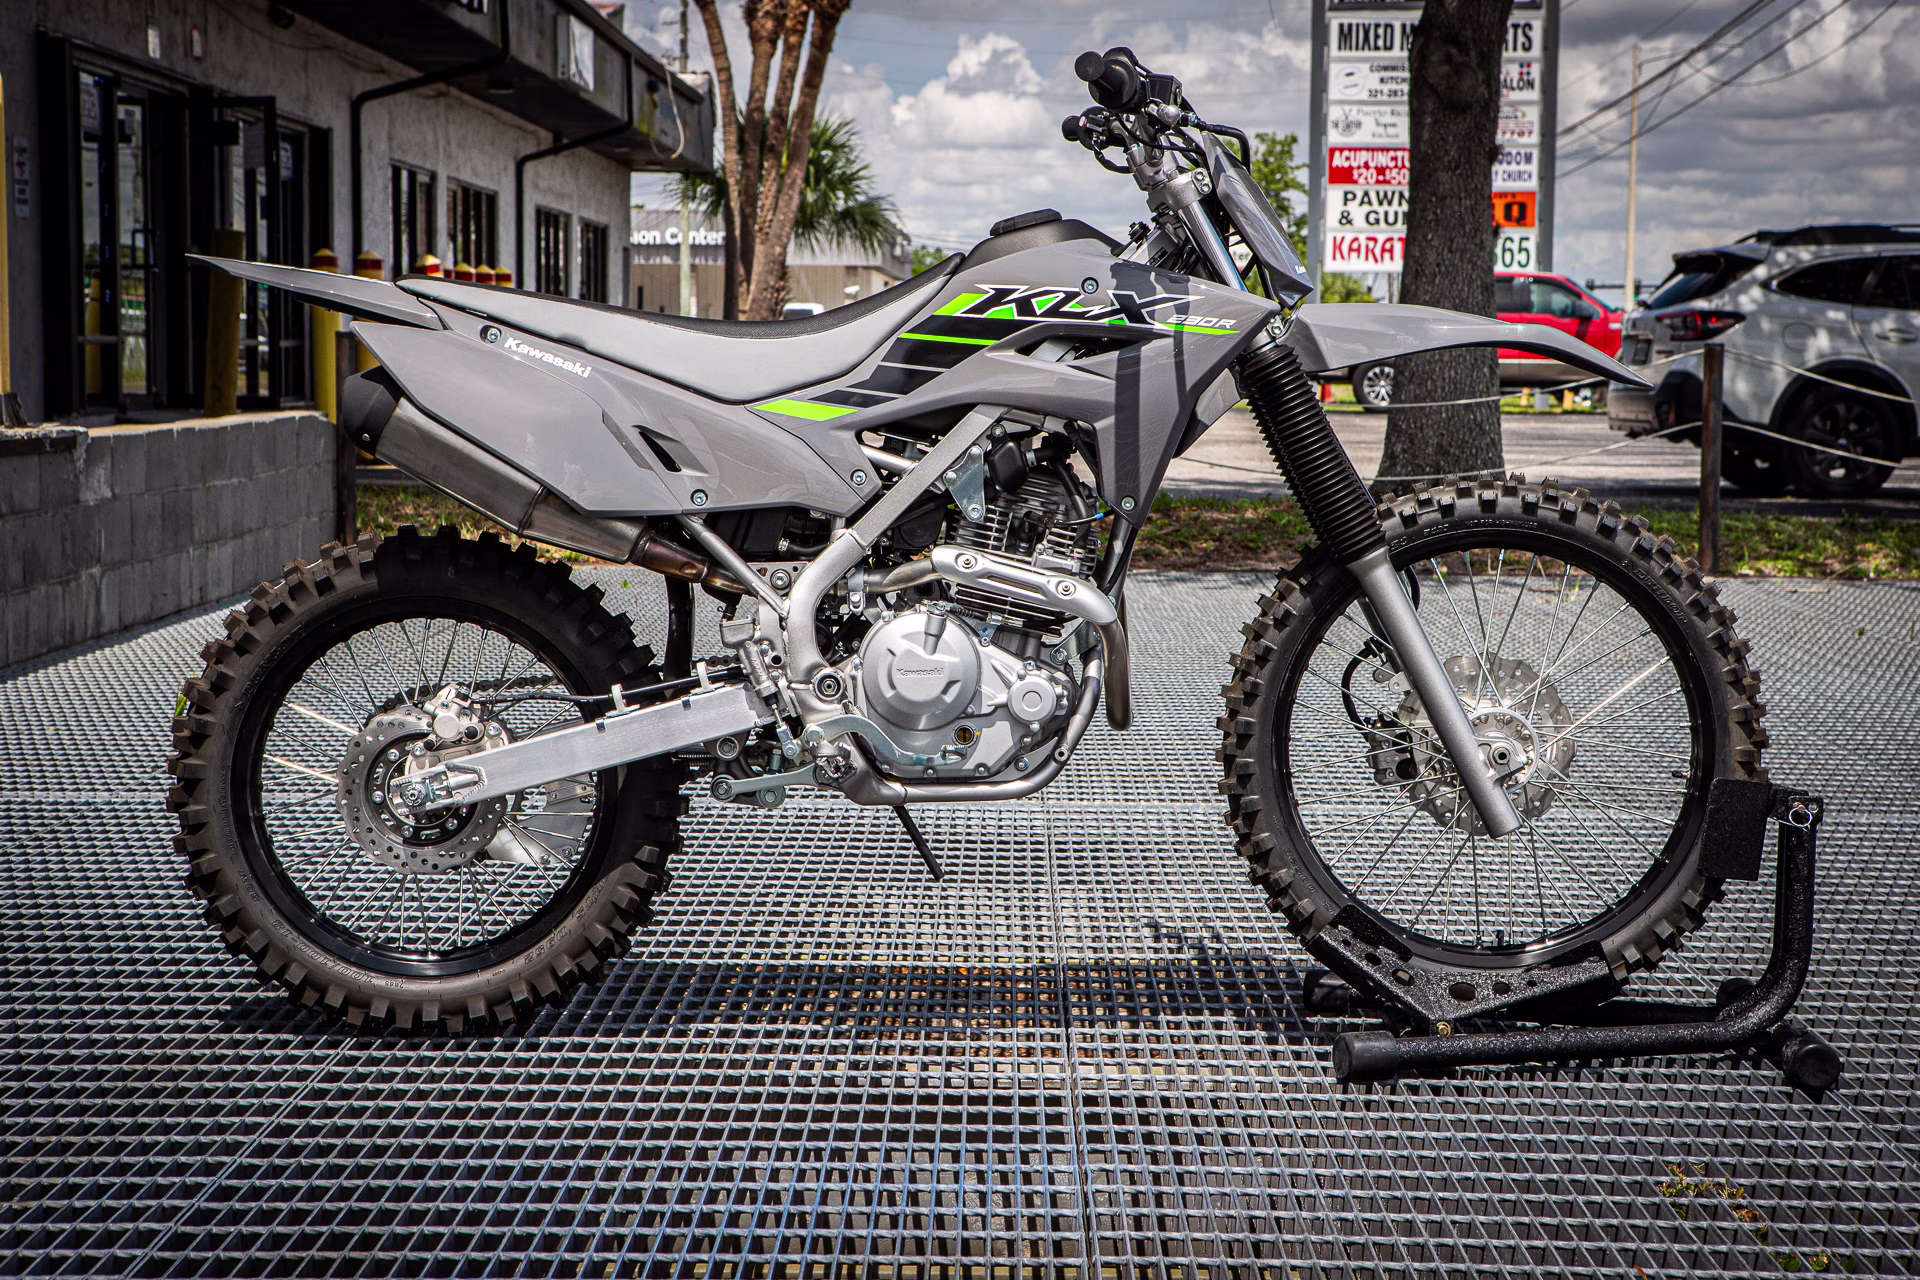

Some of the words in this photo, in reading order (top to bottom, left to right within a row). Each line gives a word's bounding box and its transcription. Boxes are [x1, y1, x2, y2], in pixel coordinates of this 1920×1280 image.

[1338, 22, 1394, 51] MIXED
[1502, 169, 1533, 182] CHURCH
[1338, 210, 1353, 226] &
[1493, 236, 1530, 268] 65
[952, 284, 1205, 330] KLX
[1166, 313, 1237, 329] 230R
[503, 336, 593, 379] Kawasaki
[896, 667, 944, 678] Kawasaki
[523, 926, 568, 965] D952
